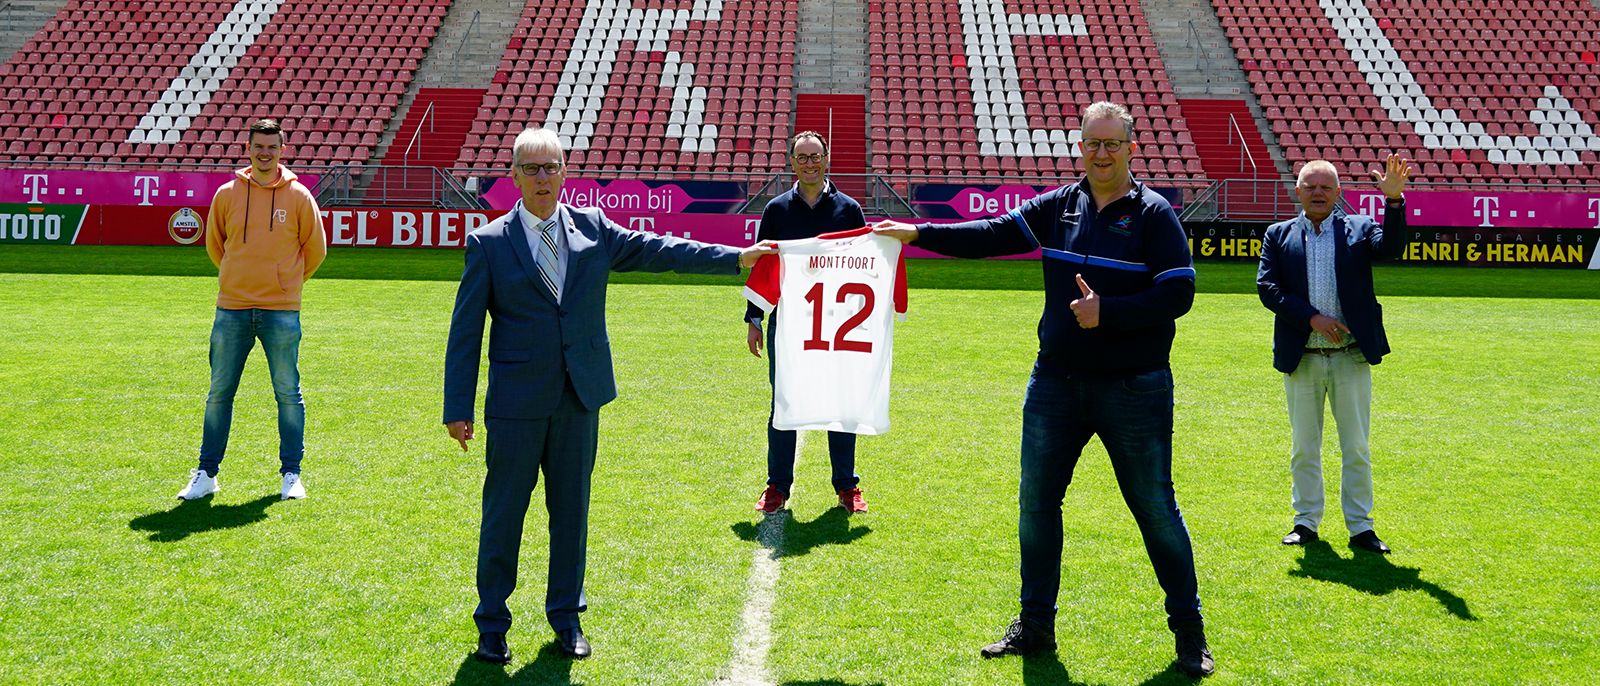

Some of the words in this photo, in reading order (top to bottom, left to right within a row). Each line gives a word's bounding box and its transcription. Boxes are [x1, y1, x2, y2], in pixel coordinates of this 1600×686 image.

[559, 187, 640, 209] Welkom
[648, 189, 672, 213] bij
[969, 193, 998, 213] De
[0, 213, 61, 241] TOTO
[391, 211, 488, 246] BIER
[809, 255, 876, 270] MONTFOORT
[1402, 242, 1459, 261] ENRI
[1466, 243, 1482, 262] &
[1487, 243, 1583, 263] HERMAN
[803, 282, 875, 354] 12
